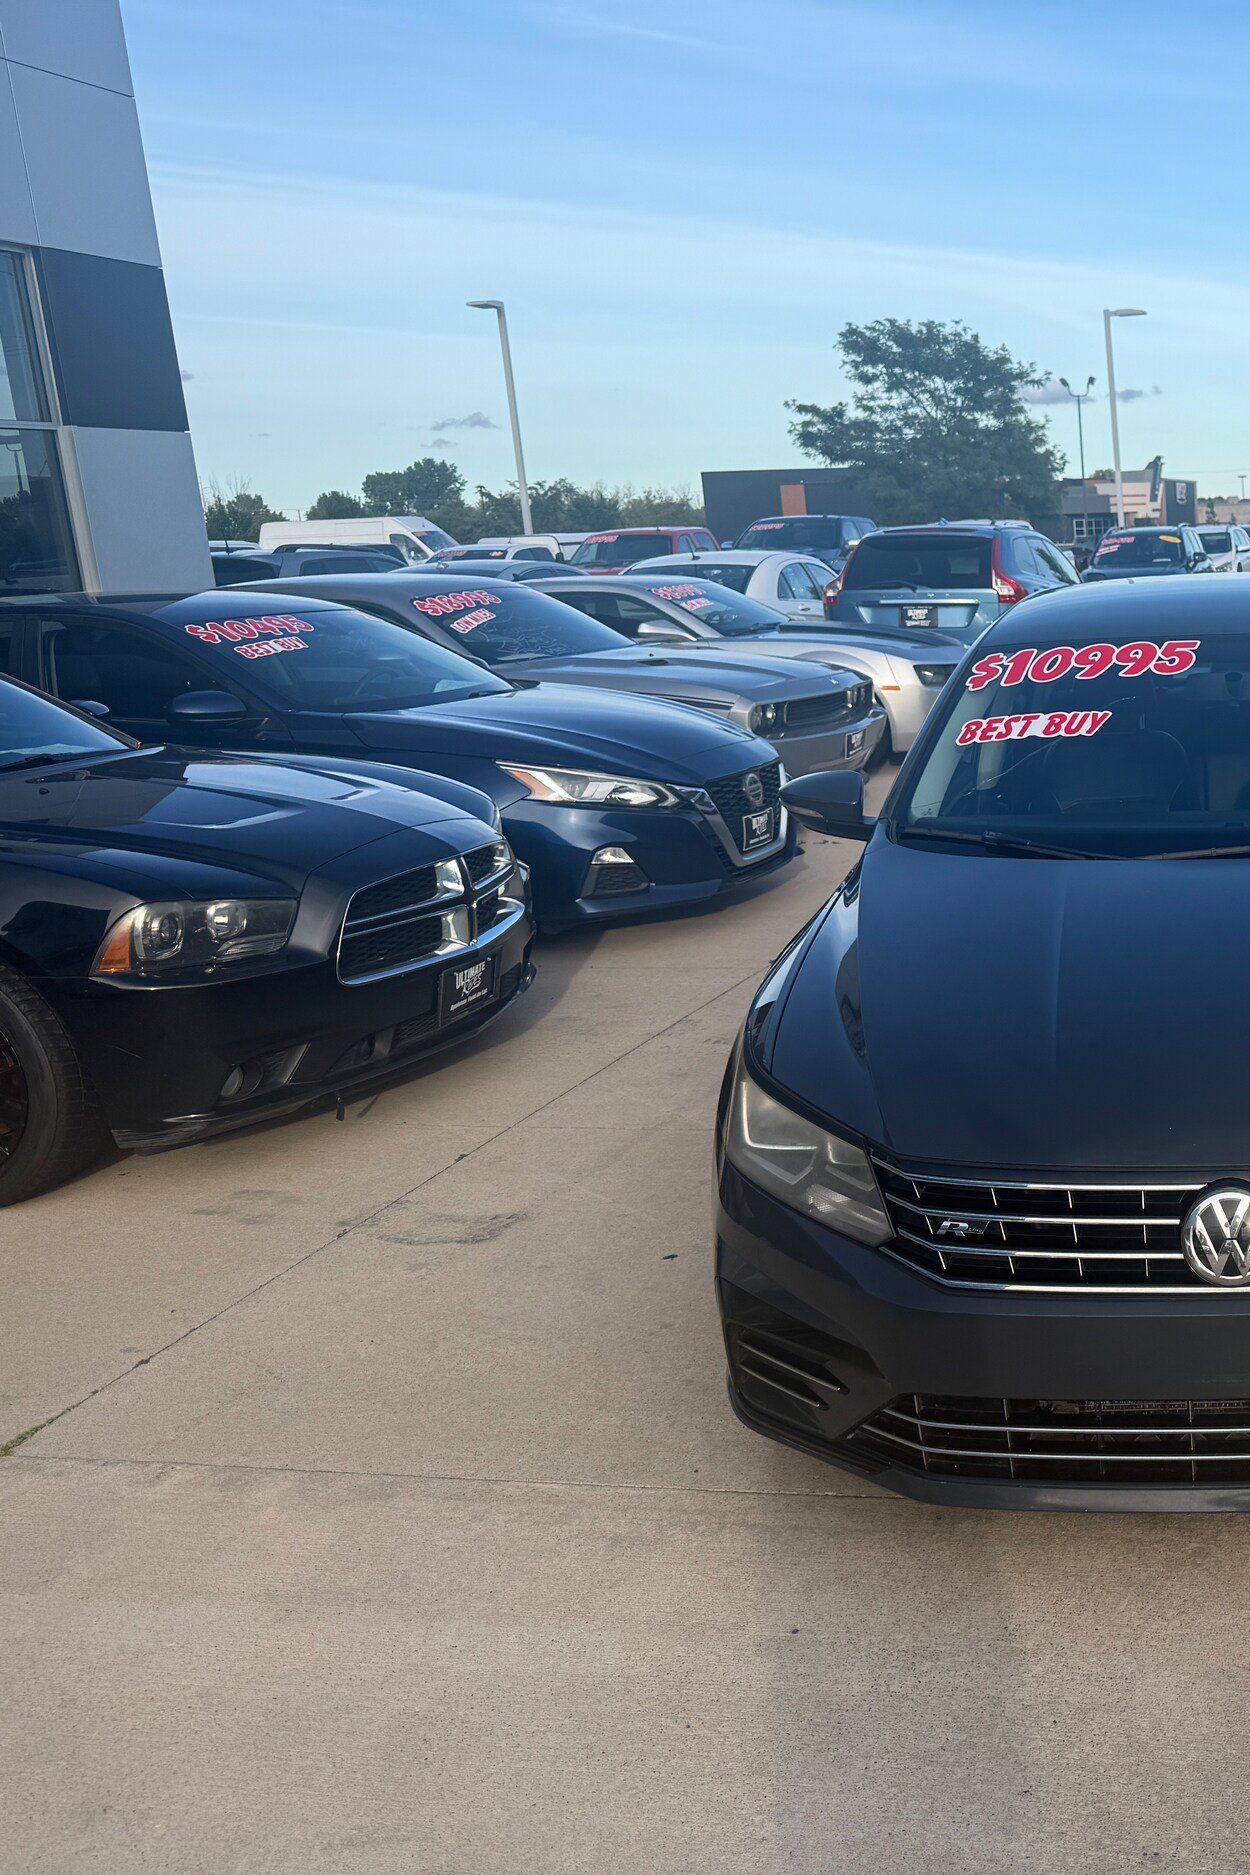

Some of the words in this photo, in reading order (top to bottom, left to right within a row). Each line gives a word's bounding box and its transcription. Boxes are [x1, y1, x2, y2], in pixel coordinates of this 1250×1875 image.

[185, 615, 314, 643] $10495
[234, 640, 275, 659] BEST
[273, 636, 309, 653] BUY
[965, 640, 1200, 691] $10995
[956, 713, 1038, 745] BEST
[1042, 711, 1112, 737] BUY
[454, 960, 486, 989] ULTIMATE
[937, 1220, 969, 1237] R
